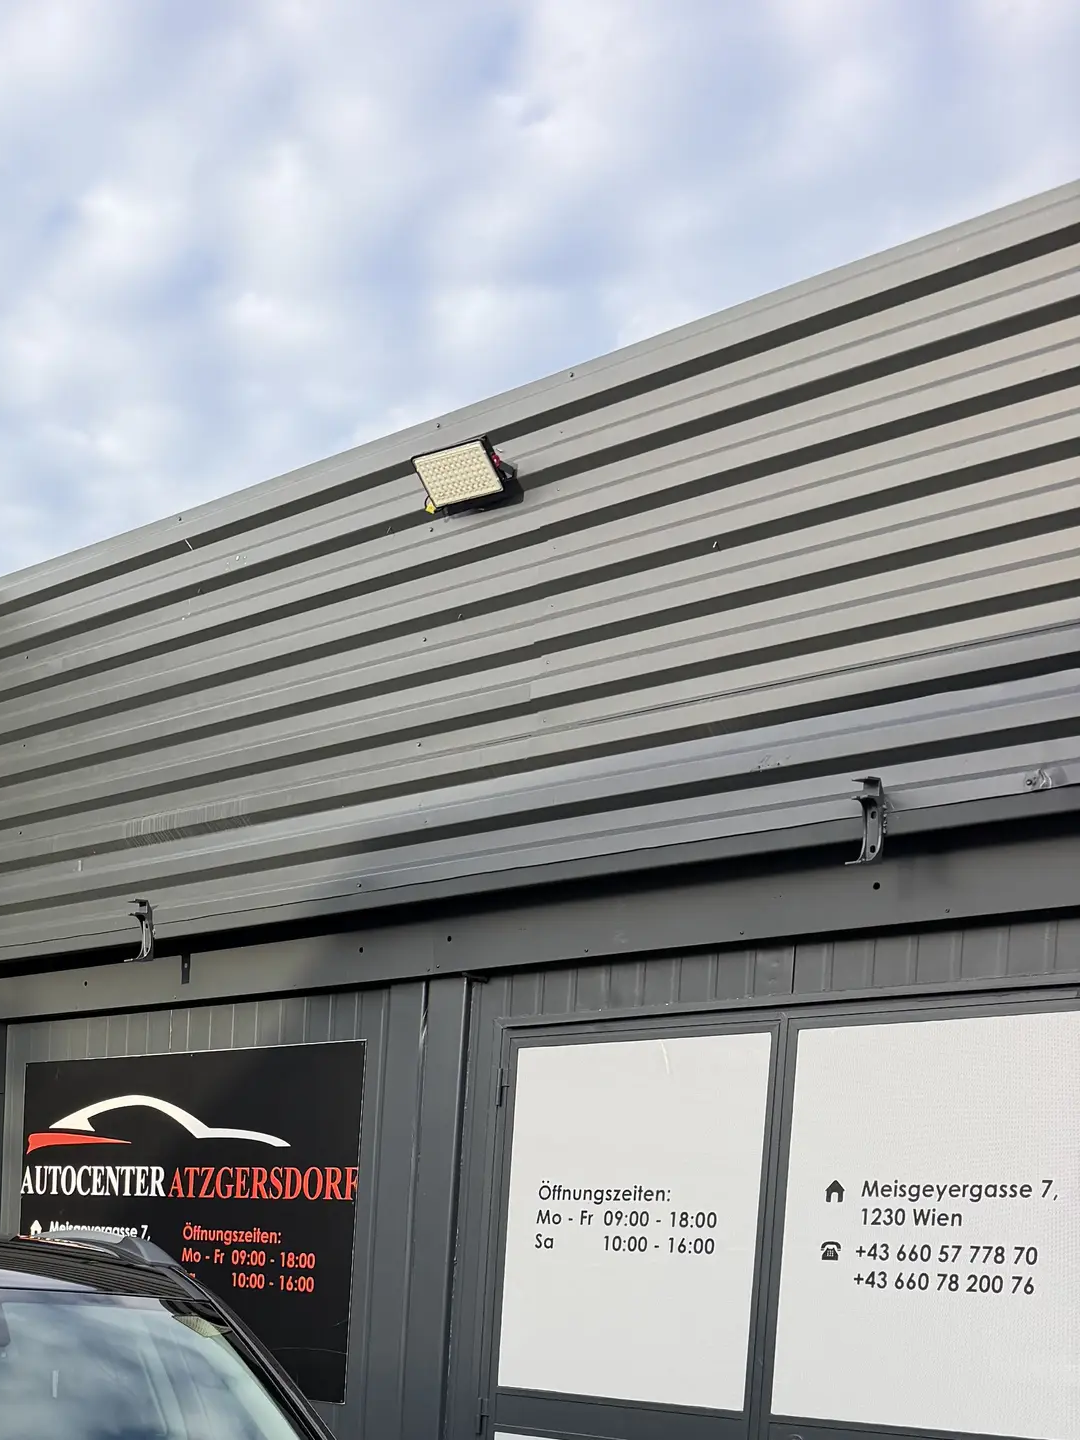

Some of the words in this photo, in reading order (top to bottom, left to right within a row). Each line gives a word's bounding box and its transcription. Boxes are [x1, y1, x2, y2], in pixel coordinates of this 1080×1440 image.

[538, 1180, 671, 1205] Öffnungszeiten:
[861, 1179, 1032, 1202] Meisgeyergasse
[1041, 1179, 1059, 1201] 7,
[536, 1209, 562, 1225] Mo
[580, 1210, 593, 1225] Fr
[603, 1210, 650, 1227] 09:00
[670, 1211, 717, 1229] 18:00
[861, 1208, 905, 1226] 1230
[913, 1208, 962, 1227] Wien
[182, 1222, 282, 1245] Öffnungszeiten:
[535, 1233, 554, 1249] Sa
[603, 1235, 648, 1252] 10:00
[668, 1237, 715, 1254] 16:00
[181, 1248, 201, 1263] Mo
[214, 1248, 225, 1264] Fr
[231, 1249, 266, 1267] 09:00
[280, 1252, 316, 1269] 18:00
[855, 1243, 890, 1261] +43
[896, 1244, 932, 1262] 660
[938, 1245, 962, 1263] 57
[969, 1245, 1006, 1264] 778
[1013, 1246, 1038, 1265] 70
[231, 1272, 265, 1289] 10:00
[279, 1275, 314, 1293] 16:00
[853, 1271, 888, 1289] +43
[894, 1272, 929, 1290] 660
[936, 1273, 960, 1292] 78
[965, 1274, 1003, 1293] 200
[1011, 1276, 1035, 1295] 76
